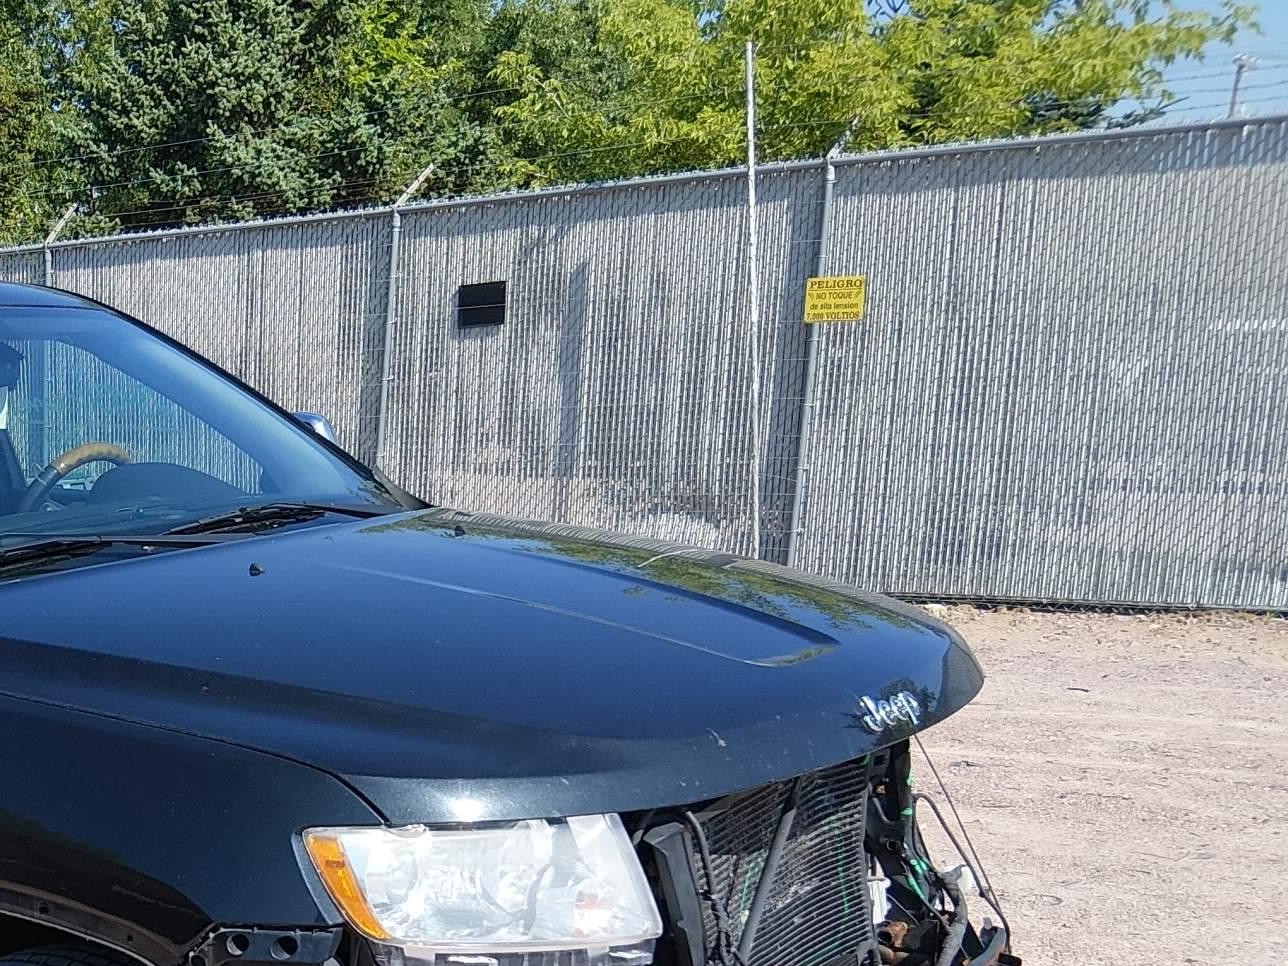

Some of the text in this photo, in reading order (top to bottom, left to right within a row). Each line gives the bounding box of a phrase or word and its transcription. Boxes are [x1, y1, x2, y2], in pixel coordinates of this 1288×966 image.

[809, 279, 863, 289] PELIGRO
[815, 291, 853, 300] NO TOQUE
[825, 311, 860, 320] VOLTIOS
[857, 690, 921, 734] Jeep
